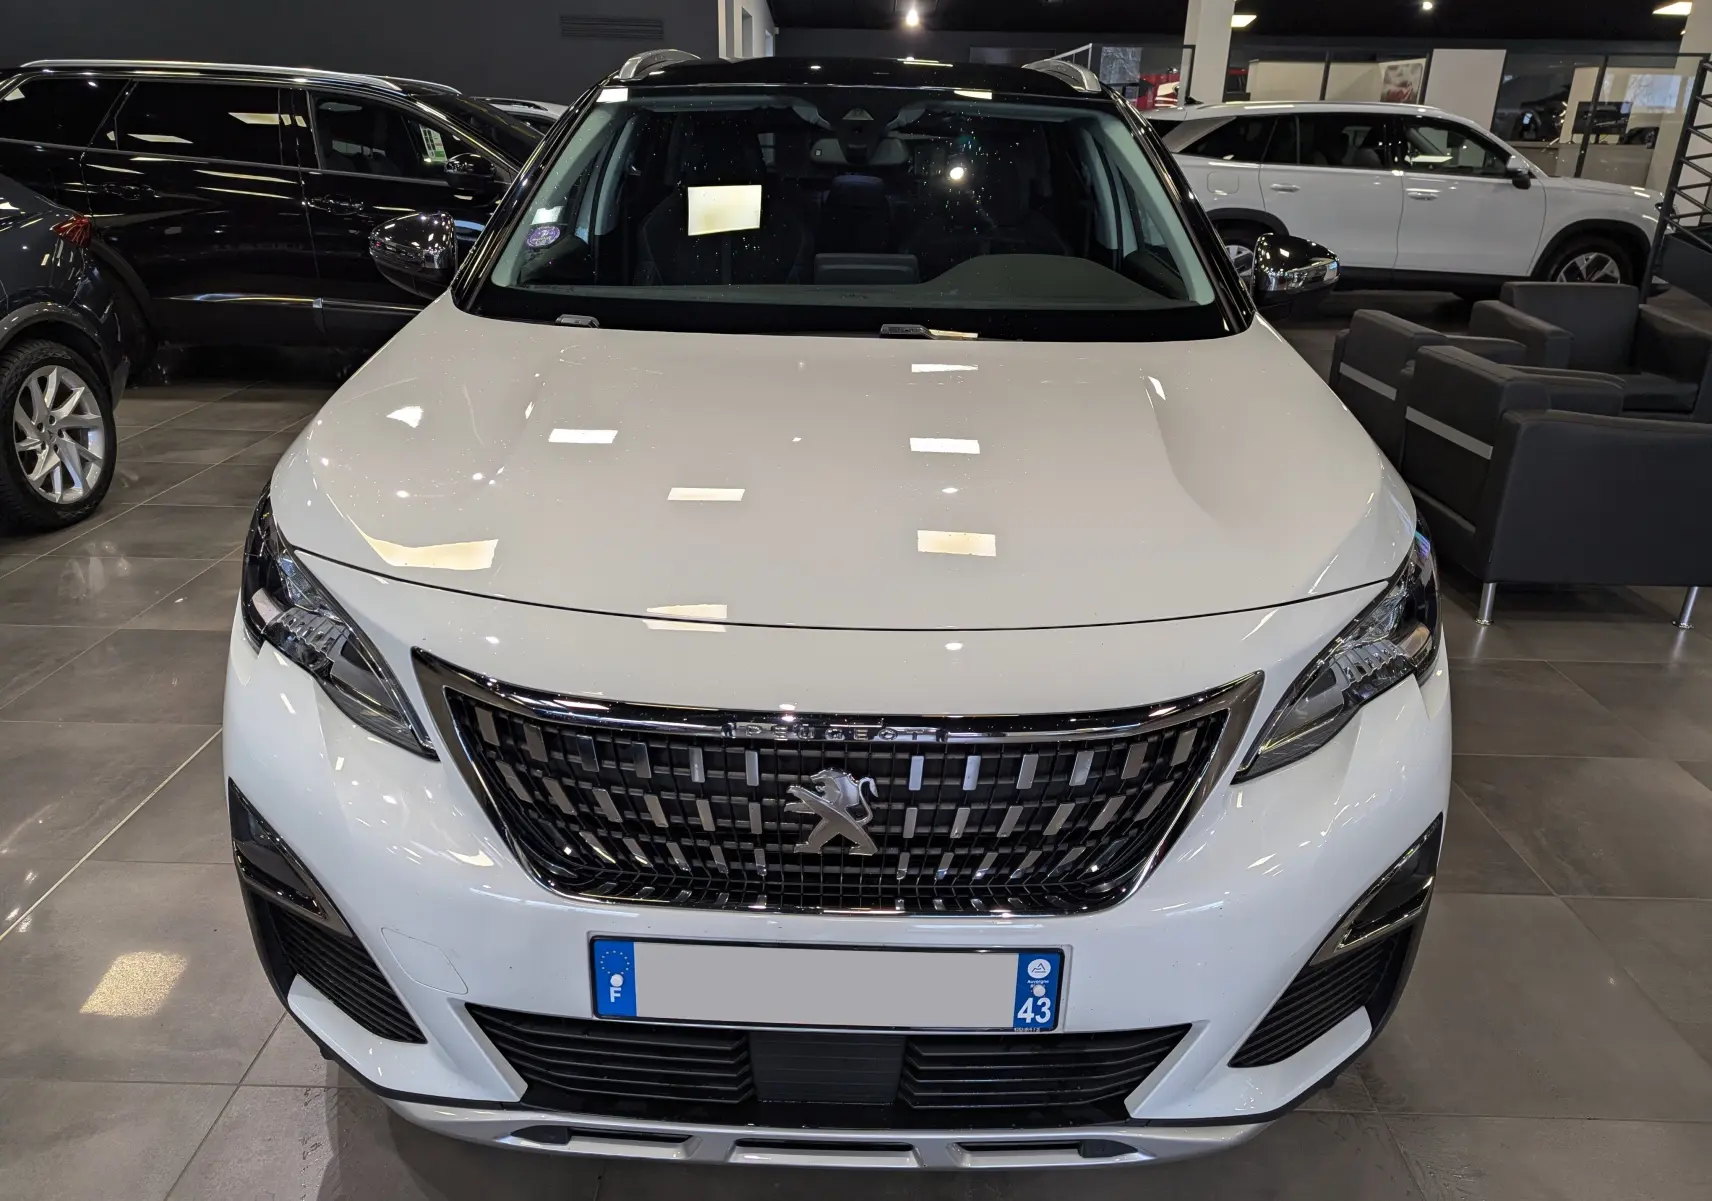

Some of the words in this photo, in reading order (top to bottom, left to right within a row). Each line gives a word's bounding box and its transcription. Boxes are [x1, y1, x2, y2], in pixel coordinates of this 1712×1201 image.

[746, 725, 925, 741] PEUGEOT
[610, 987, 621, 1002] F
[1017, 997, 1051, 1023] 43
